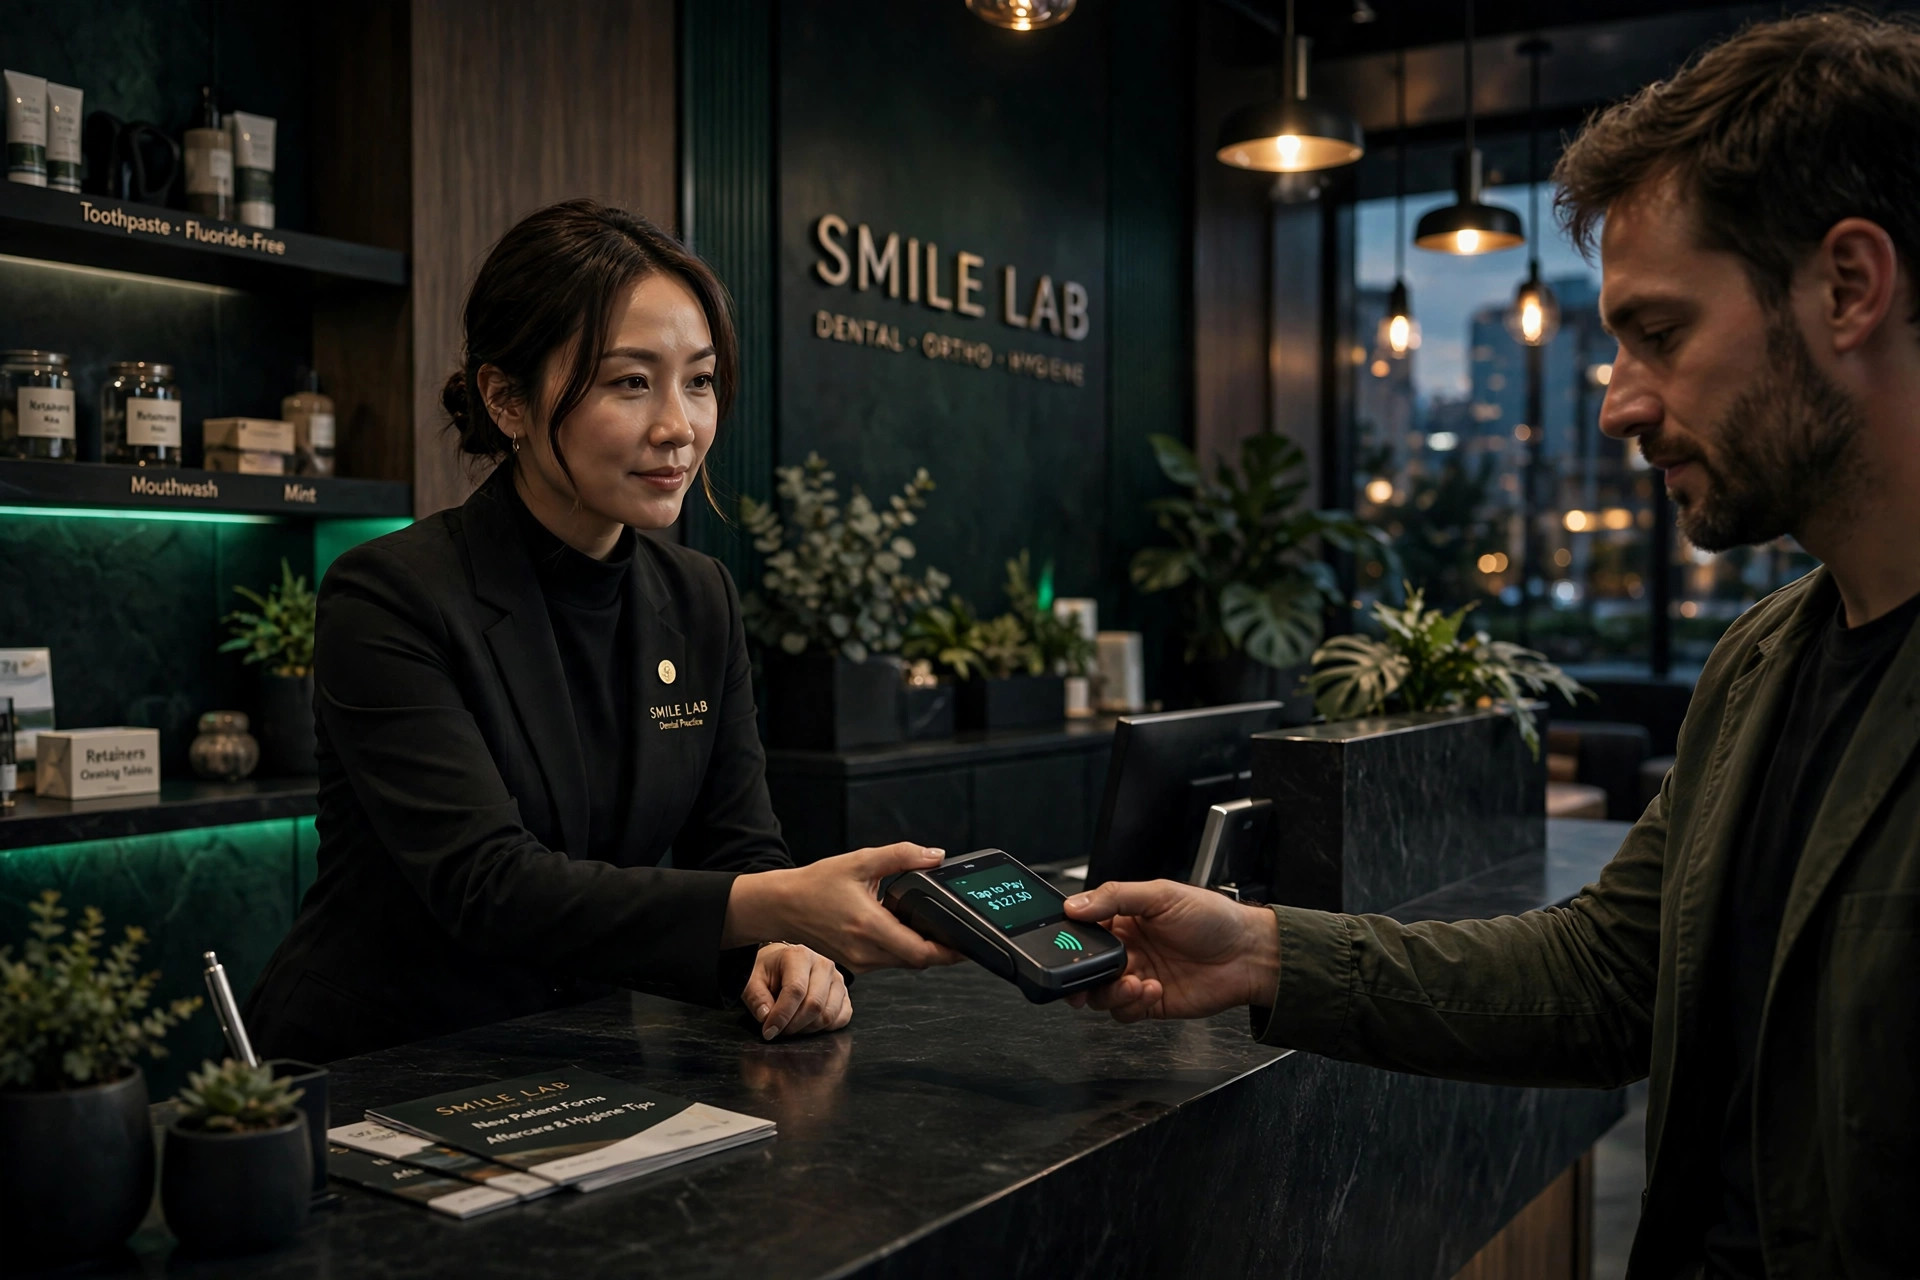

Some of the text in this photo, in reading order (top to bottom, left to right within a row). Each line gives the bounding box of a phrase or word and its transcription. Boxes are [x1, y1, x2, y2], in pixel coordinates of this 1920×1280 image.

[80, 200, 287, 256] Toothpaste Fluoride-Free
[814, 213, 1091, 342] SMILE LAB
[815, 309, 904, 354] DENTAL
[130, 475, 219, 499] Mouthwash
[283, 482, 318, 504] Mint
[649, 700, 709, 719] SMILE LAB
[967, 879, 1025, 900] Tap to Pay
[987, 890, 1033, 911] $127.50
[436, 1092, 516, 1117] SMILE
[519, 1080, 571, 1098] LAB
[471, 1116, 510, 1131] New
[508, 1103, 561, 1123] Patient
[559, 1094, 608, 1111] Forms
[486, 1099, 657, 1146] Aftercare & Hygiene Tips
